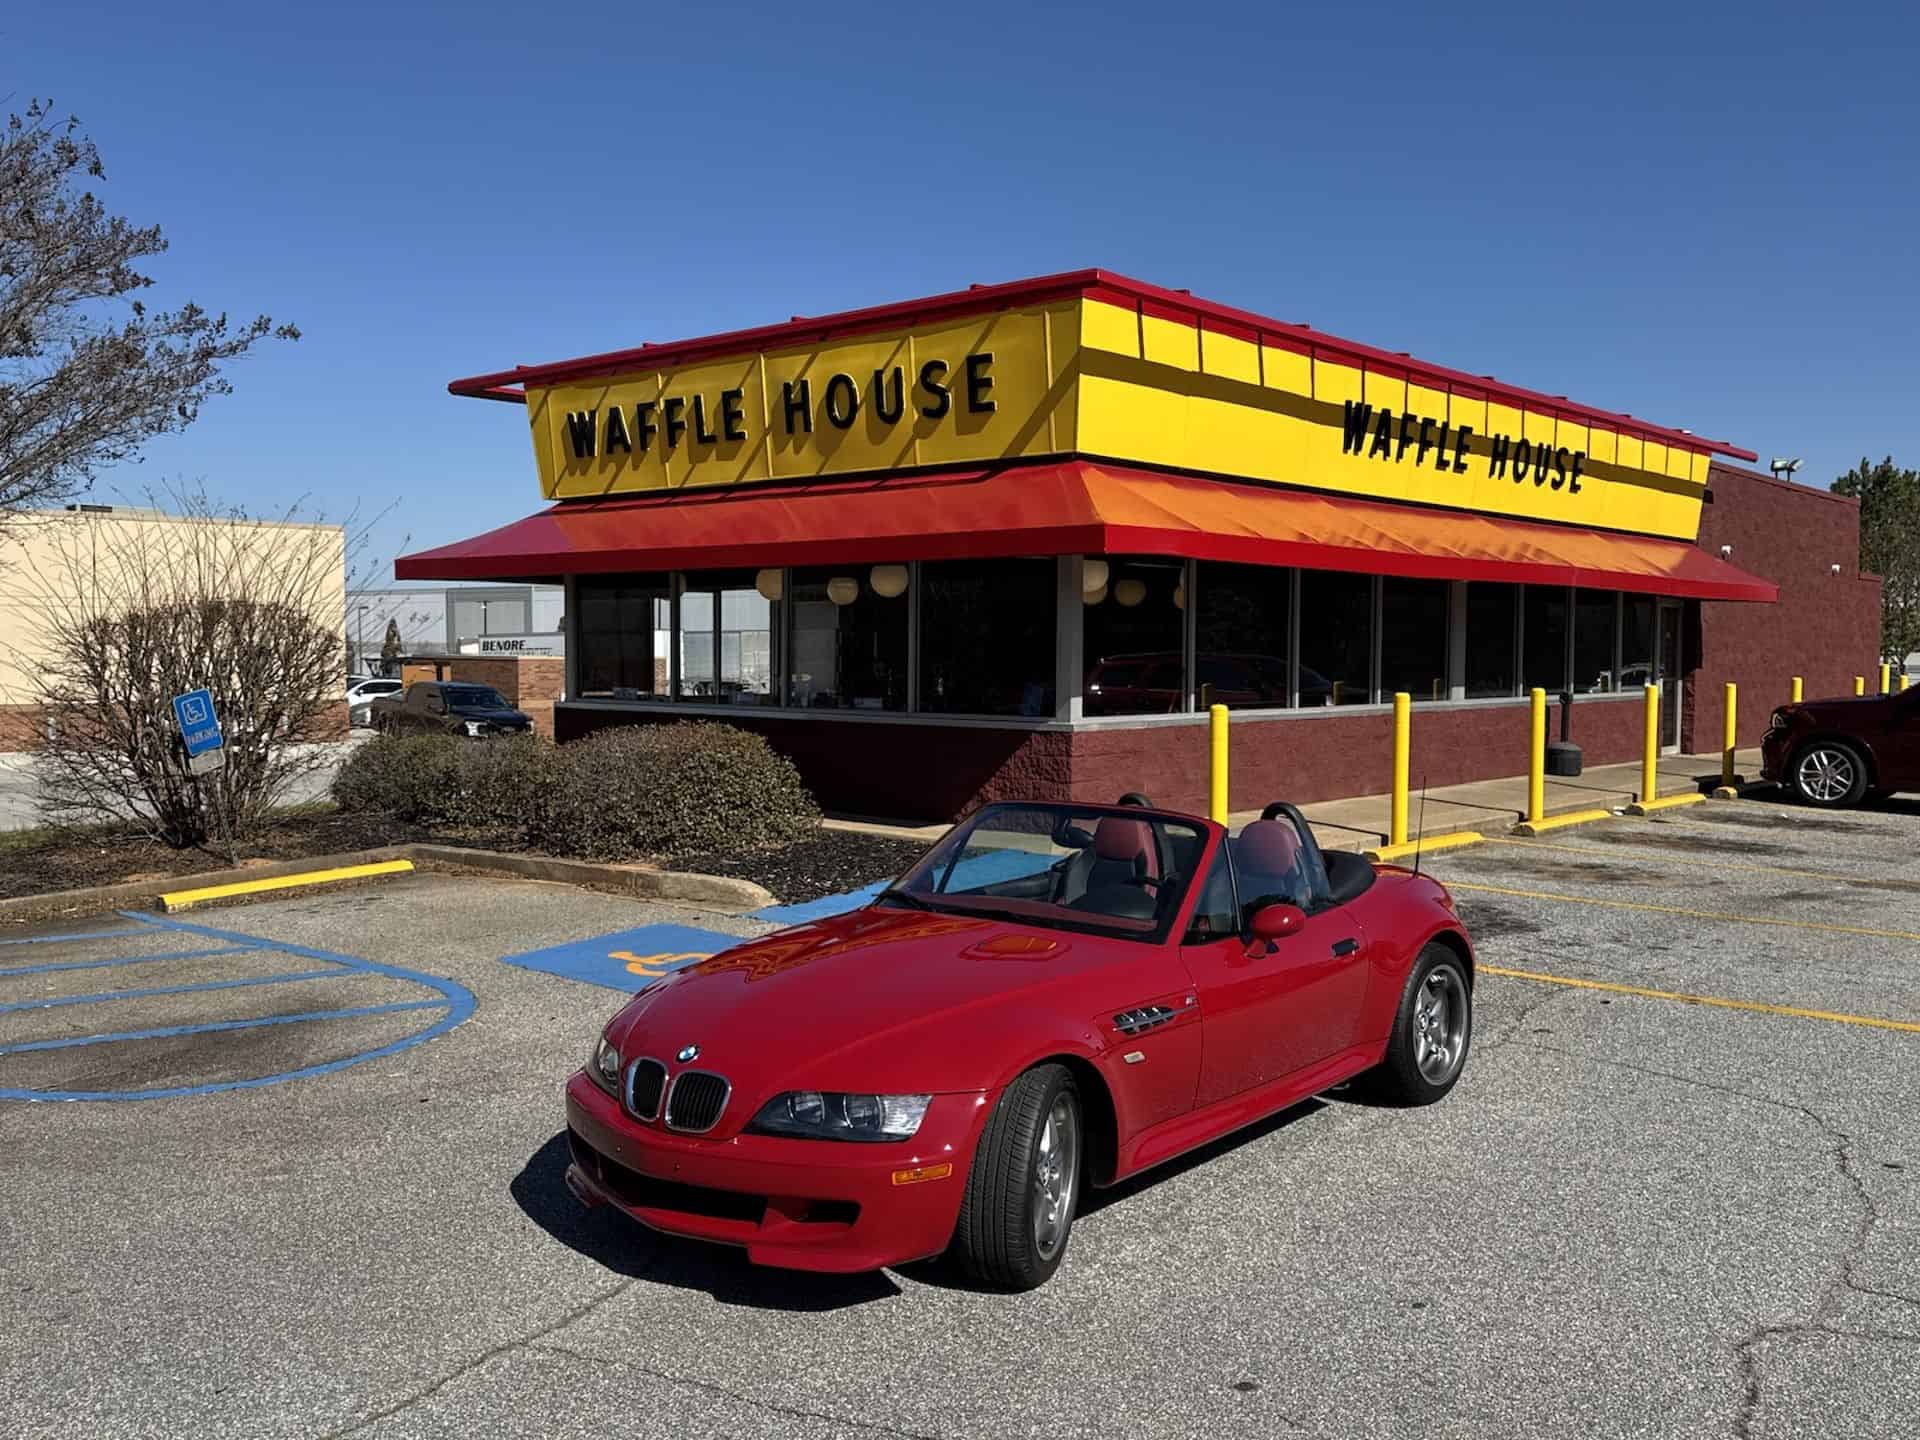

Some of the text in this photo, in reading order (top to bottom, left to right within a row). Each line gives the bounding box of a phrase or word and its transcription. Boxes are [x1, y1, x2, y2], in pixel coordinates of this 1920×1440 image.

[567, 352, 998, 458] WAFFLE HOUSE
[1343, 399, 1586, 494] WAFFLE HOUSE
[482, 640, 526, 651] BENORE
